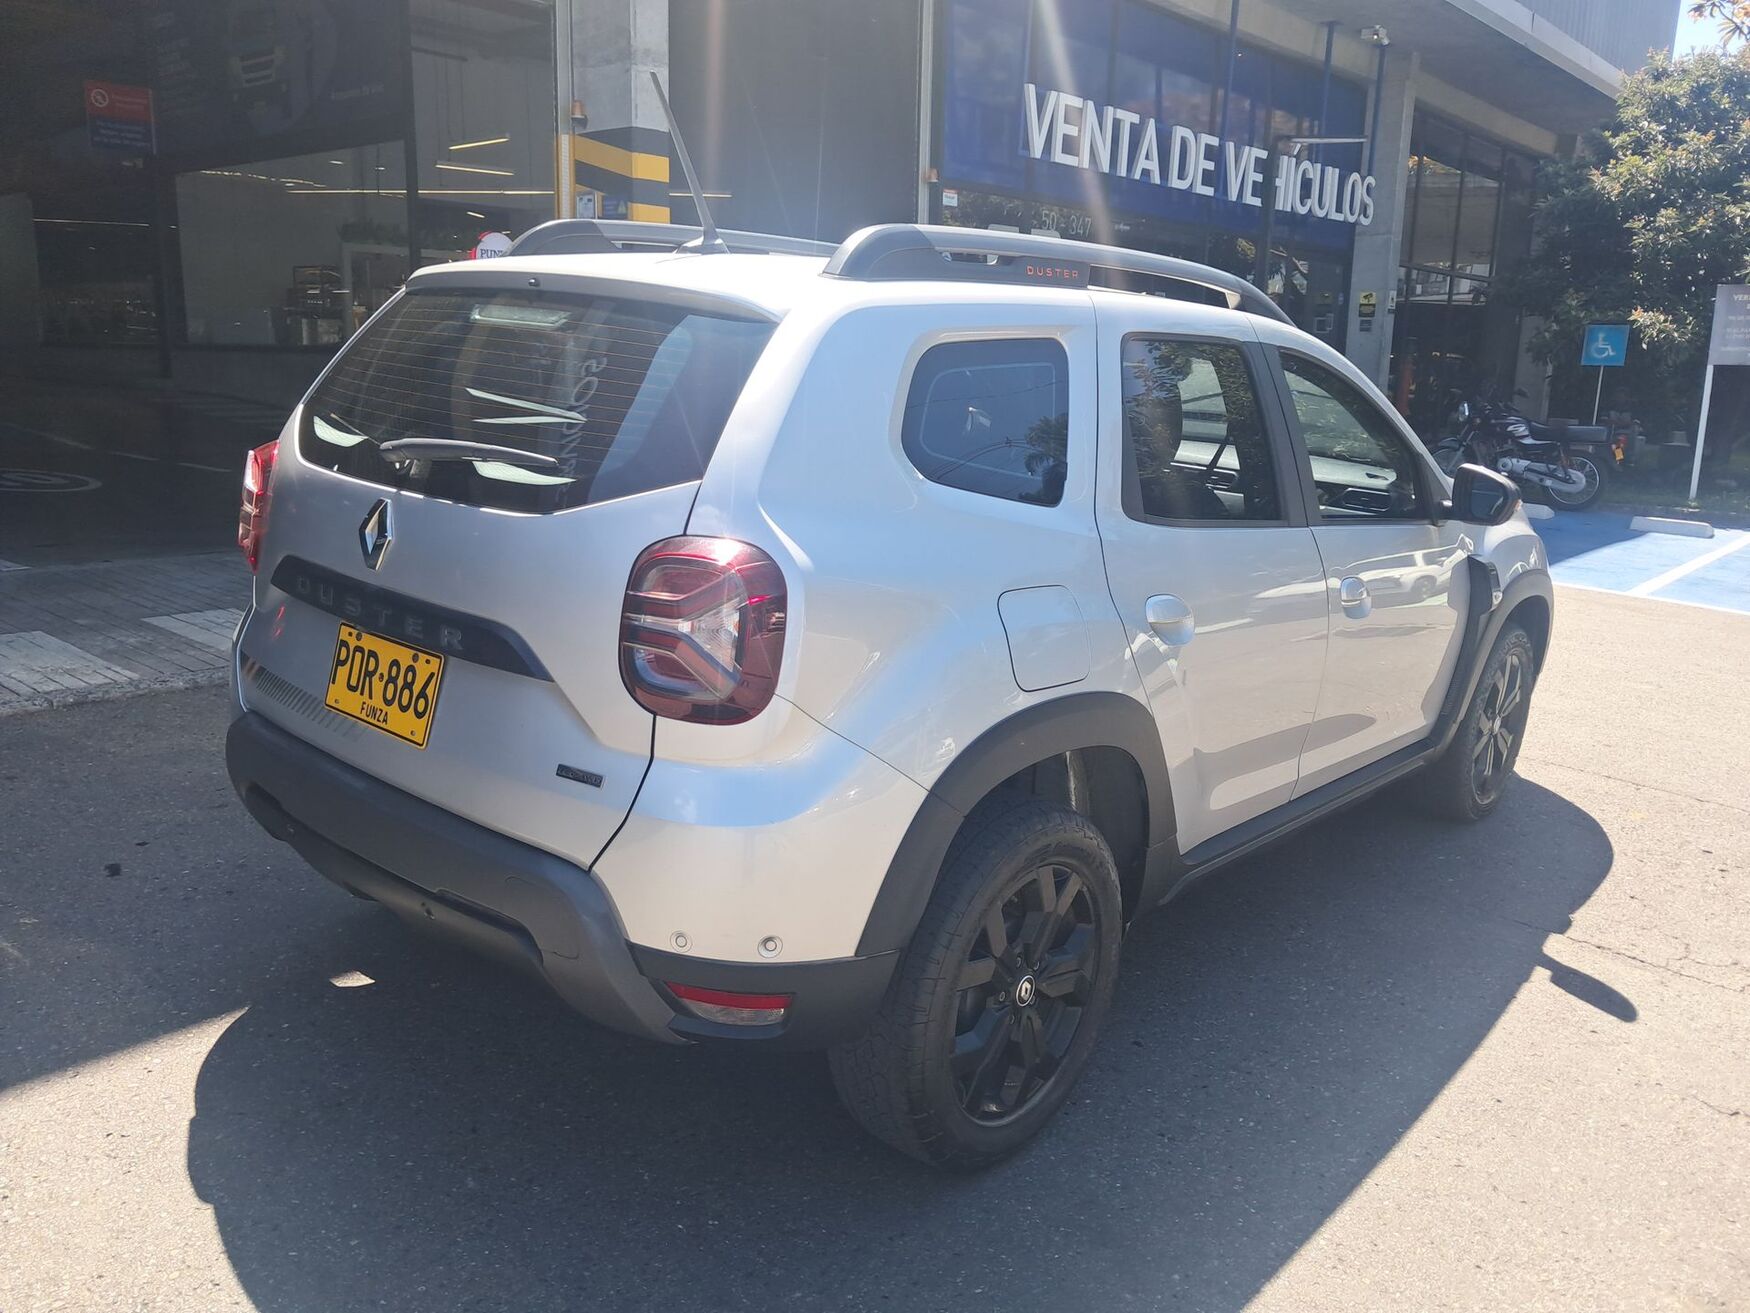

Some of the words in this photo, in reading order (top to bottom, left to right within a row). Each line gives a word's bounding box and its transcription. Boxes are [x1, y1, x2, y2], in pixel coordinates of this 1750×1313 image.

[1024, 83, 1161, 184] VENTA
[1167, 125, 1219, 197] DE
[1069, 215, 1092, 237] 347
[1026, 265, 1079, 279] DUSTER
[298, 577, 463, 650] DUSTER
[360, 701, 388, 725] FUNZA
